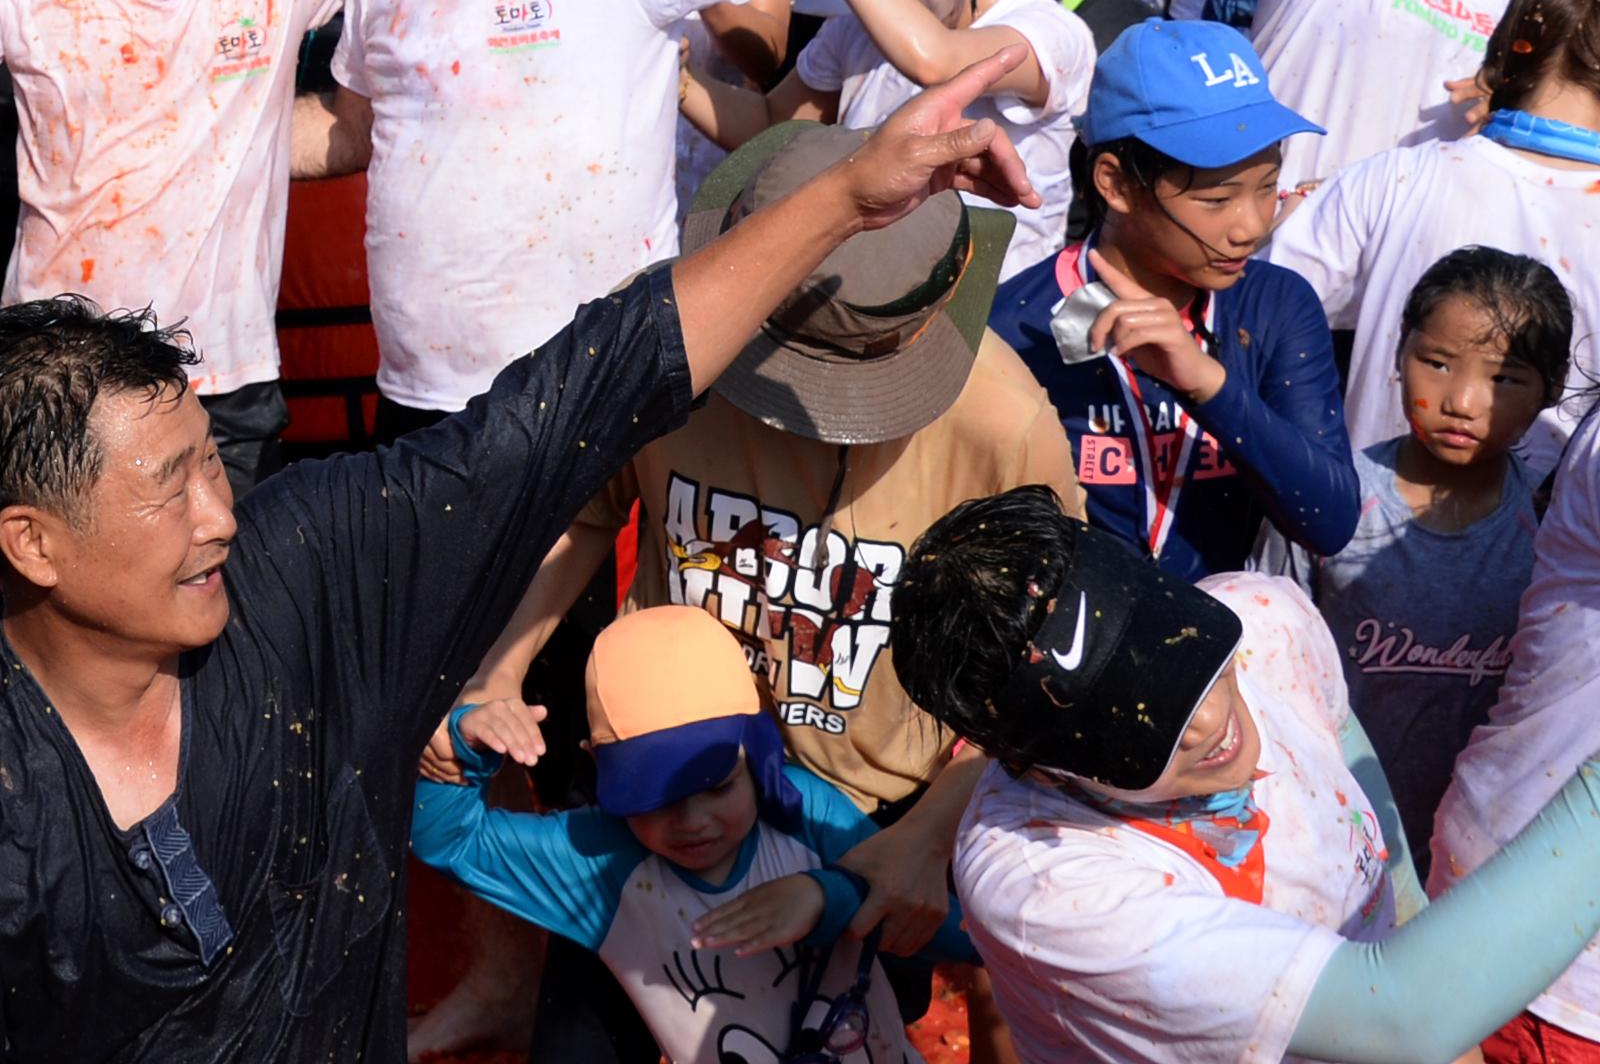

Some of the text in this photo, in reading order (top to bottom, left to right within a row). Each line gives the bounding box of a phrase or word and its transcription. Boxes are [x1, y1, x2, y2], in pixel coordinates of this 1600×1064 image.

[495, 1, 544, 25] 토마토
[1190, 52, 1260, 88] LA
[1084, 438, 1096, 480] STREET
